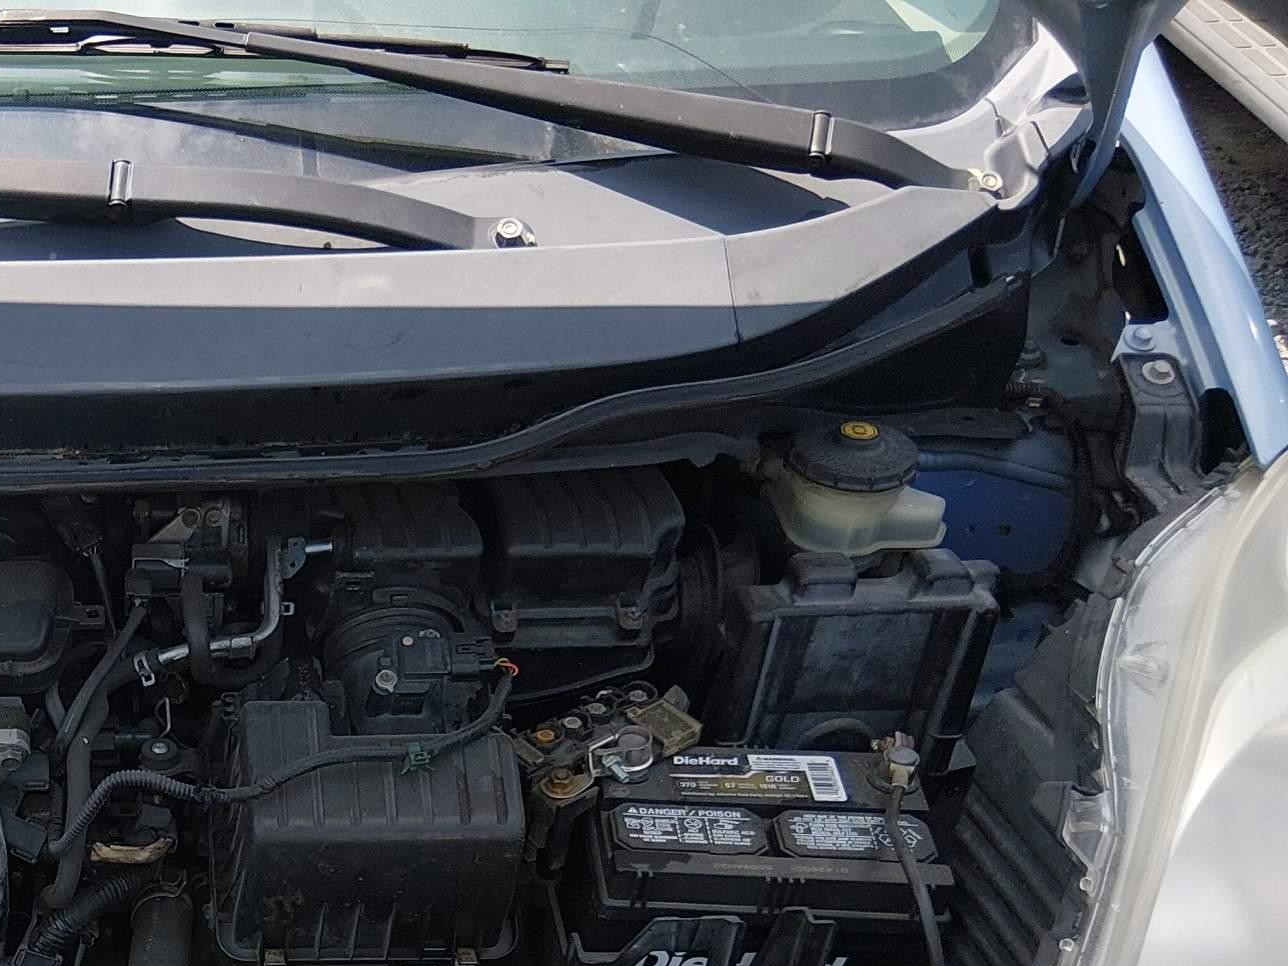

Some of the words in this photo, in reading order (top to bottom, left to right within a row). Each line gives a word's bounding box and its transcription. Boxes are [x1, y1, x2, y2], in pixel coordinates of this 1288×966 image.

[673, 755, 739, 766] DieHard
[765, 775, 801, 783] GOLD
[638, 808, 686, 816] DANGER
[698, 810, 741, 818] POISON
